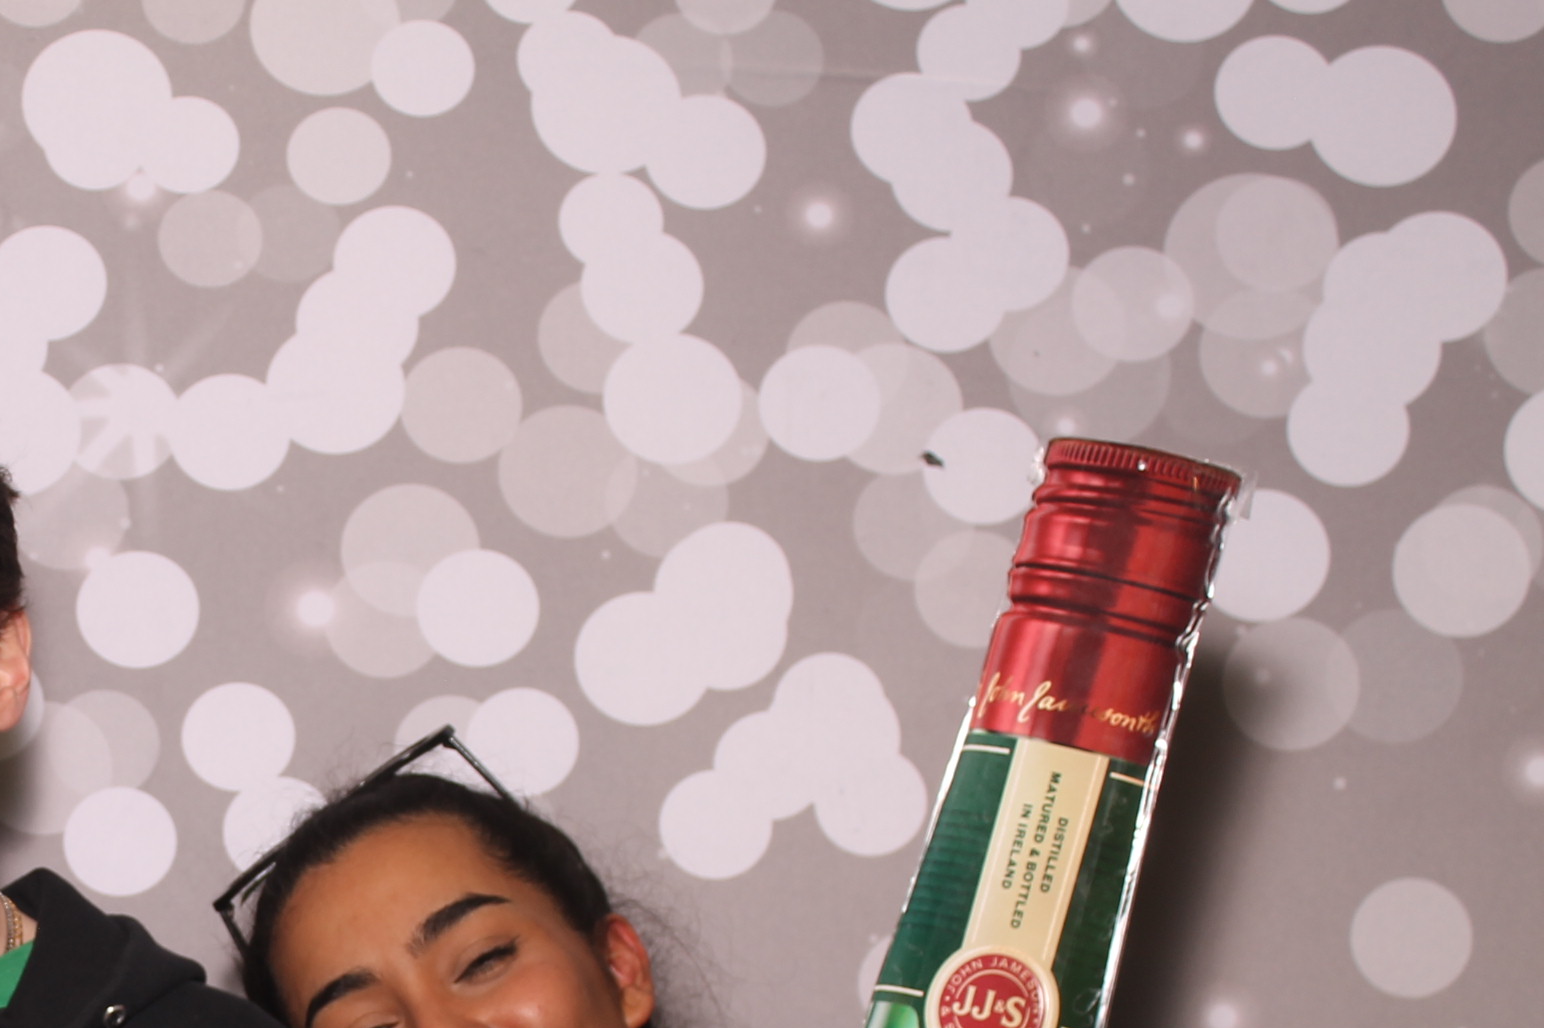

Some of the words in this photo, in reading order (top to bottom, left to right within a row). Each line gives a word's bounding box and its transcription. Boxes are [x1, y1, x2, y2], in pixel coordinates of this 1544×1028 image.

[1020, 803, 1033, 819] IN
[1034, 771, 1062, 844] MATURED
[1002, 823, 1028, 889] IRELAND
[1028, 847, 1041, 858] &
[1040, 817, 1069, 893] DISTILLED
[1010, 861, 1037, 929] BOTTLED
[946, 958, 983, 994] JOHN
[990, 957, 1040, 1014] JAMESO
[952, 984, 1026, 1028] JJ&S
